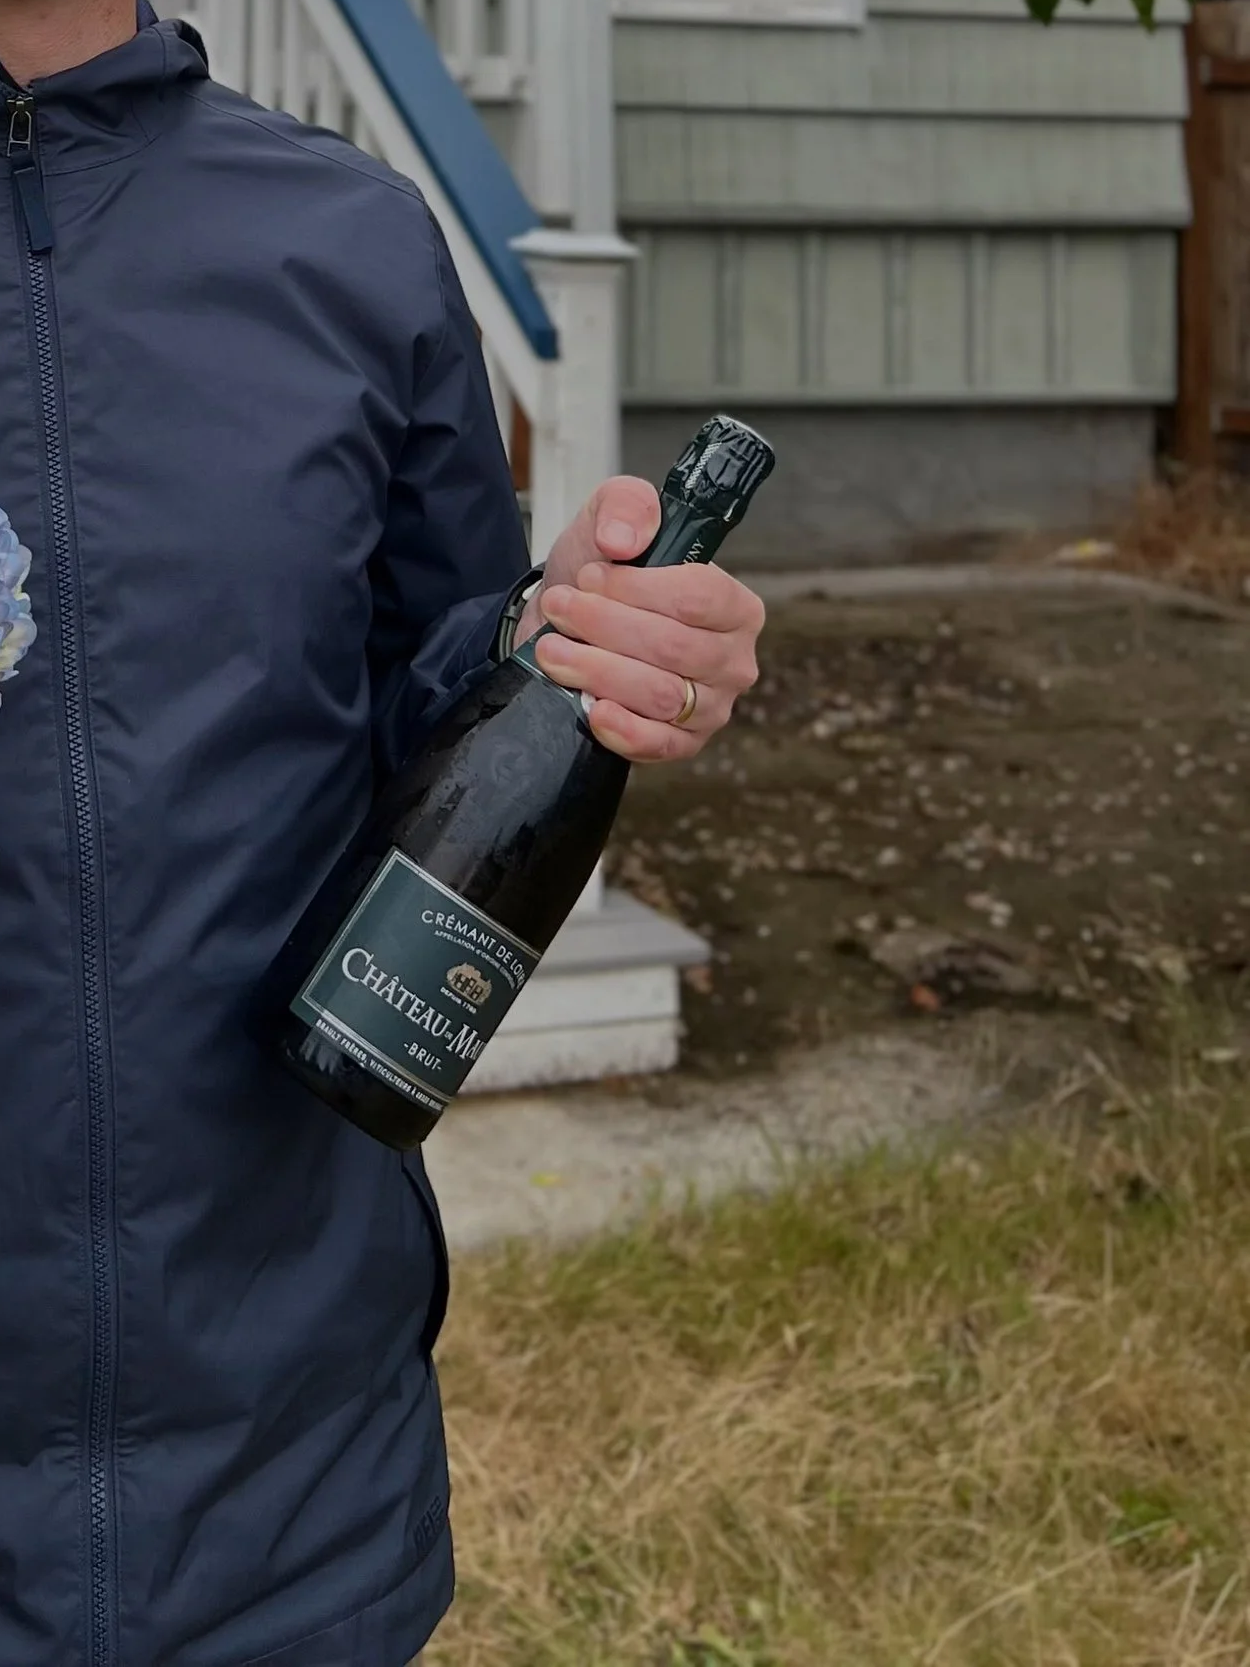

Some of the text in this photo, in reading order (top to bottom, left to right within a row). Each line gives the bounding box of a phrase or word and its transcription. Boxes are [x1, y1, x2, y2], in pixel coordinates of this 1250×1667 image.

[421, 910, 496, 950] CRÉMANT
[495, 945, 513, 964] DE
[341, 947, 452, 1037] CHÂTEAU
